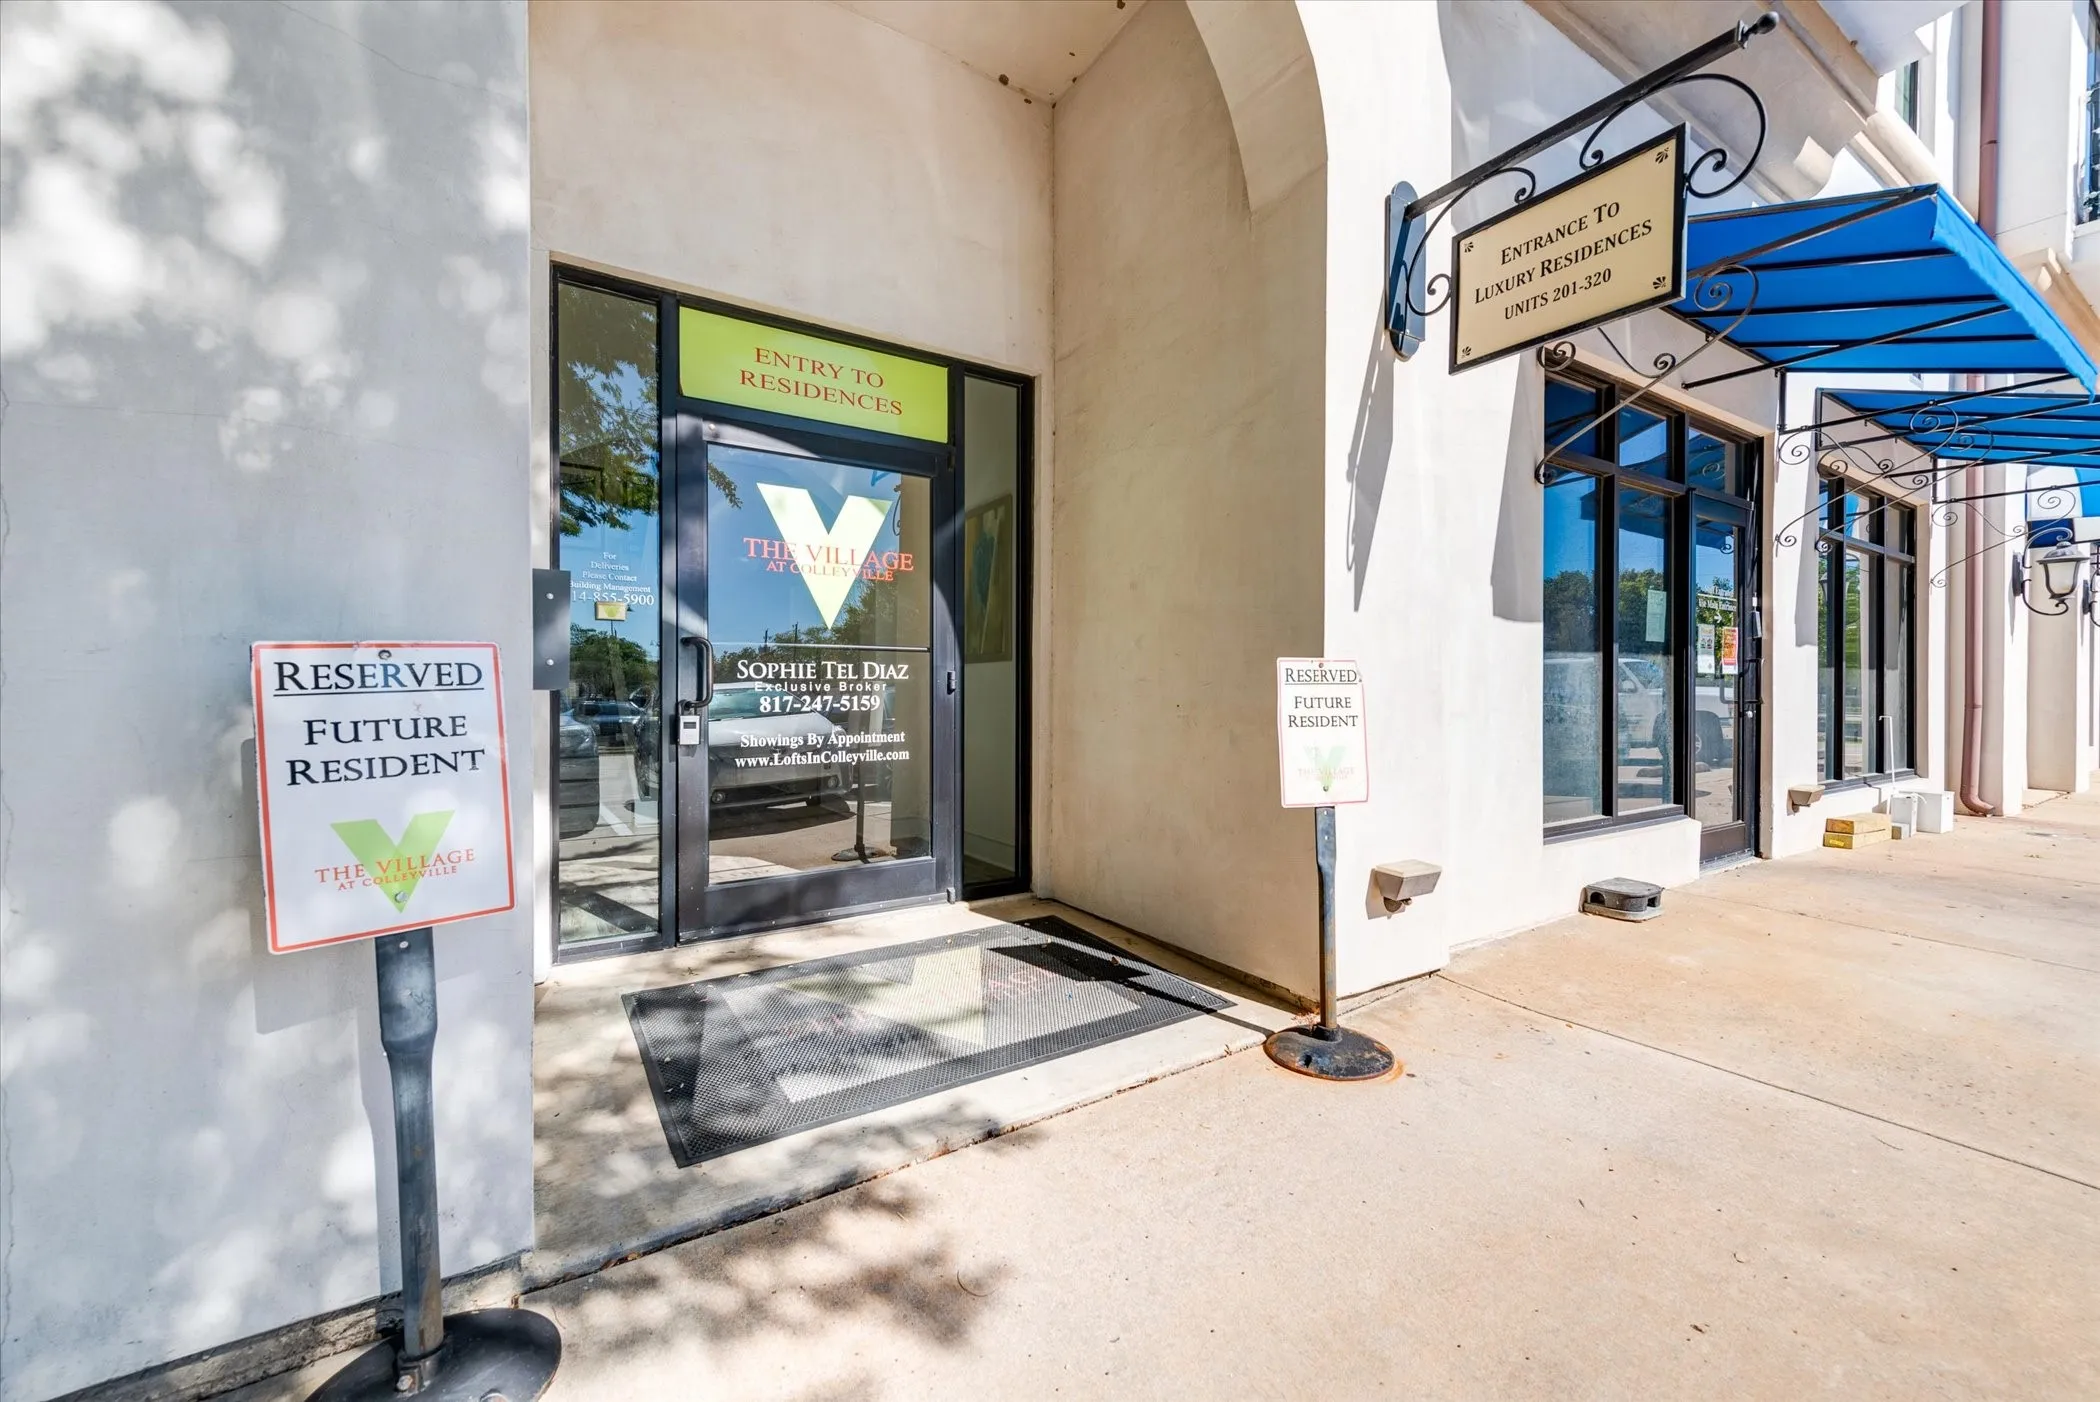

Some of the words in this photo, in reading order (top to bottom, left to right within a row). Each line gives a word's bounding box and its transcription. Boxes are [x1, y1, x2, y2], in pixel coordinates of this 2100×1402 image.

[1500, 214, 1588, 266] ENTRANCE
[1593, 201, 1620, 225] TO
[1475, 267, 1536, 304] LUXURY
[1540, 219, 1653, 278] RESIDENCES
[1504, 292, 1548, 320] UNITS
[1552, 268, 1613, 303] 201-320
[754, 347, 844, 380] ENTRY
[851, 368, 884, 388] TO
[739, 369, 903, 416] RESIDENCES
[603, 552, 616, 560] For
[743, 537, 797, 561] THE
[806, 545, 914, 571] VILLAGE
[582, 571, 606, 580] Please
[609, 573, 637, 582] Contact
[591, 561, 629, 571] Deliveries
[766, 561, 786, 572] AT
[790, 563, 894, 582] COLLEYVILLE
[572, 591, 655, 606] 14-855-5900
[603, 583, 651, 593] Management
[274, 661, 483, 691] RESERVED
[737, 659, 817, 680] SOPHIE
[821, 661, 858, 680] TEL
[862, 661, 909, 680] DIAZ
[1285, 667, 1357, 683] RESERVED
[754, 681, 831, 692] Exclusive
[839, 682, 887, 692] Broker
[759, 695, 881, 713] 817-247-5159
[1294, 695, 1352, 709] FUTURE
[304, 715, 468, 746] FUTURE
[1288, 714, 1358, 728] RESIDENT
[740, 734, 804, 749] Showings
[806, 733, 825, 747] By
[827, 730, 906, 746] Appointment
[285, 749, 486, 786] RESIDENT
[735, 749, 910, 768] www.LoftsInColleyville.com
[315, 863, 365, 883] THE
[376, 848, 475, 874] VILLAGE
[338, 880, 355, 891] AT
[362, 865, 457, 887] COLLEYVILLE
